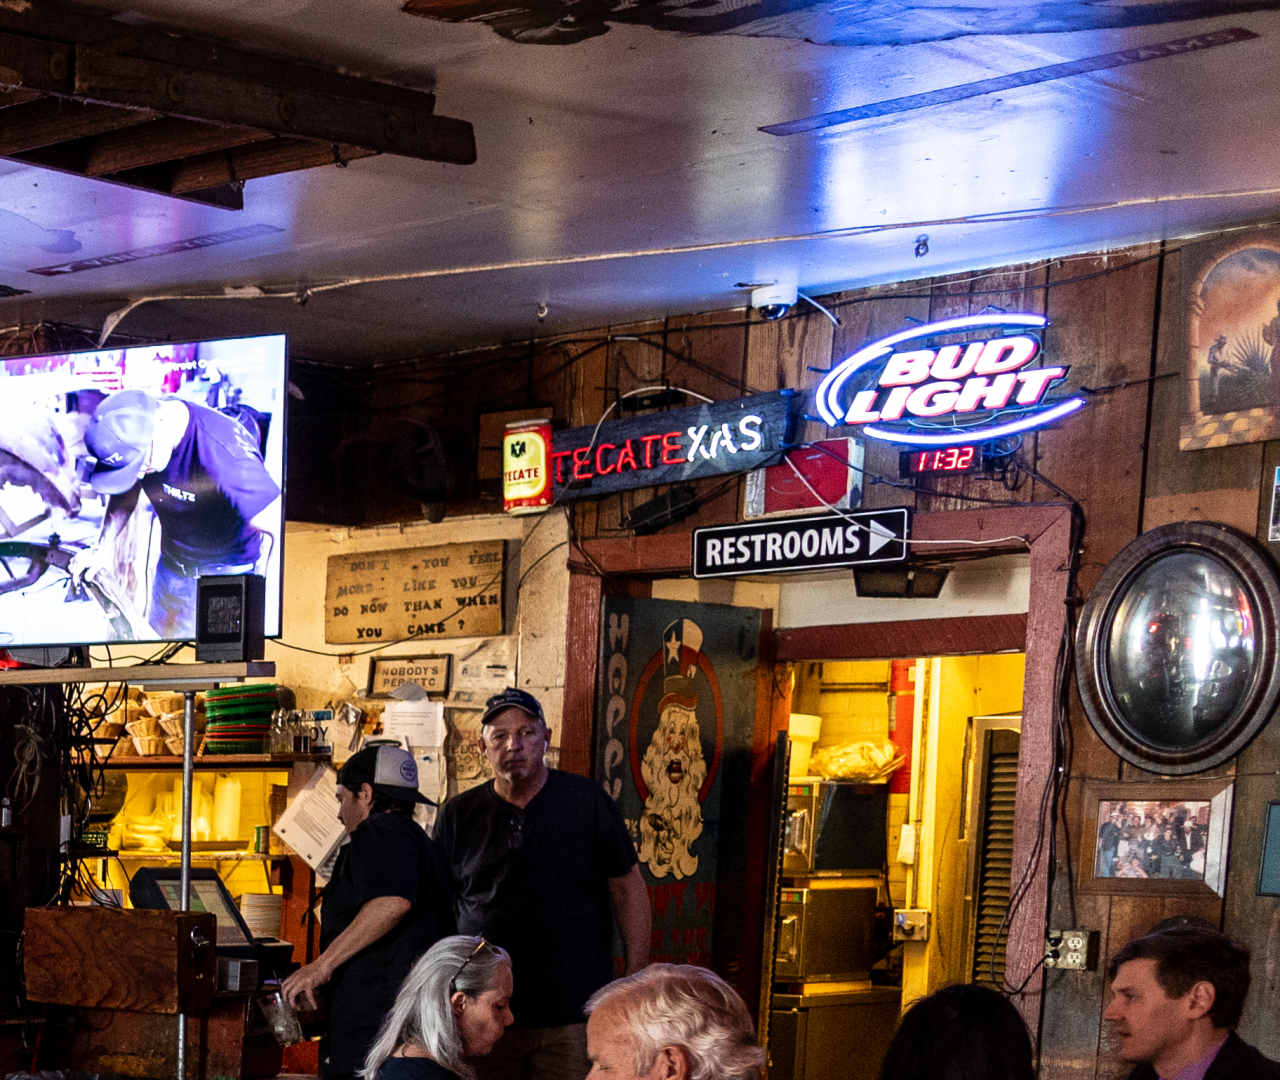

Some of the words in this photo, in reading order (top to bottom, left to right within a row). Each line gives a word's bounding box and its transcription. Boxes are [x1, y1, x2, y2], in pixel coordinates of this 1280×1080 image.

[878, 336, 1038, 388] BUD
[844, 366, 1066, 424] LIGHT
[918, 447, 975, 472] 11:32
[705, 526, 861, 567] RESTROOMS
[422, 557, 449, 569] YOU
[403, 579, 437, 593] LIKE
[451, 575, 478, 589] YOU
[333, 606, 349, 617] DO
[360, 602, 388, 615] NOW
[404, 599, 443, 612] THAN
[456, 594, 498, 607] WHEN
[356, 627, 383, 639] YOU
[407, 622, 446, 635] CAME
[381, 666, 439, 677] NOBODY'S
[383, 677, 436, 687] PERETC
